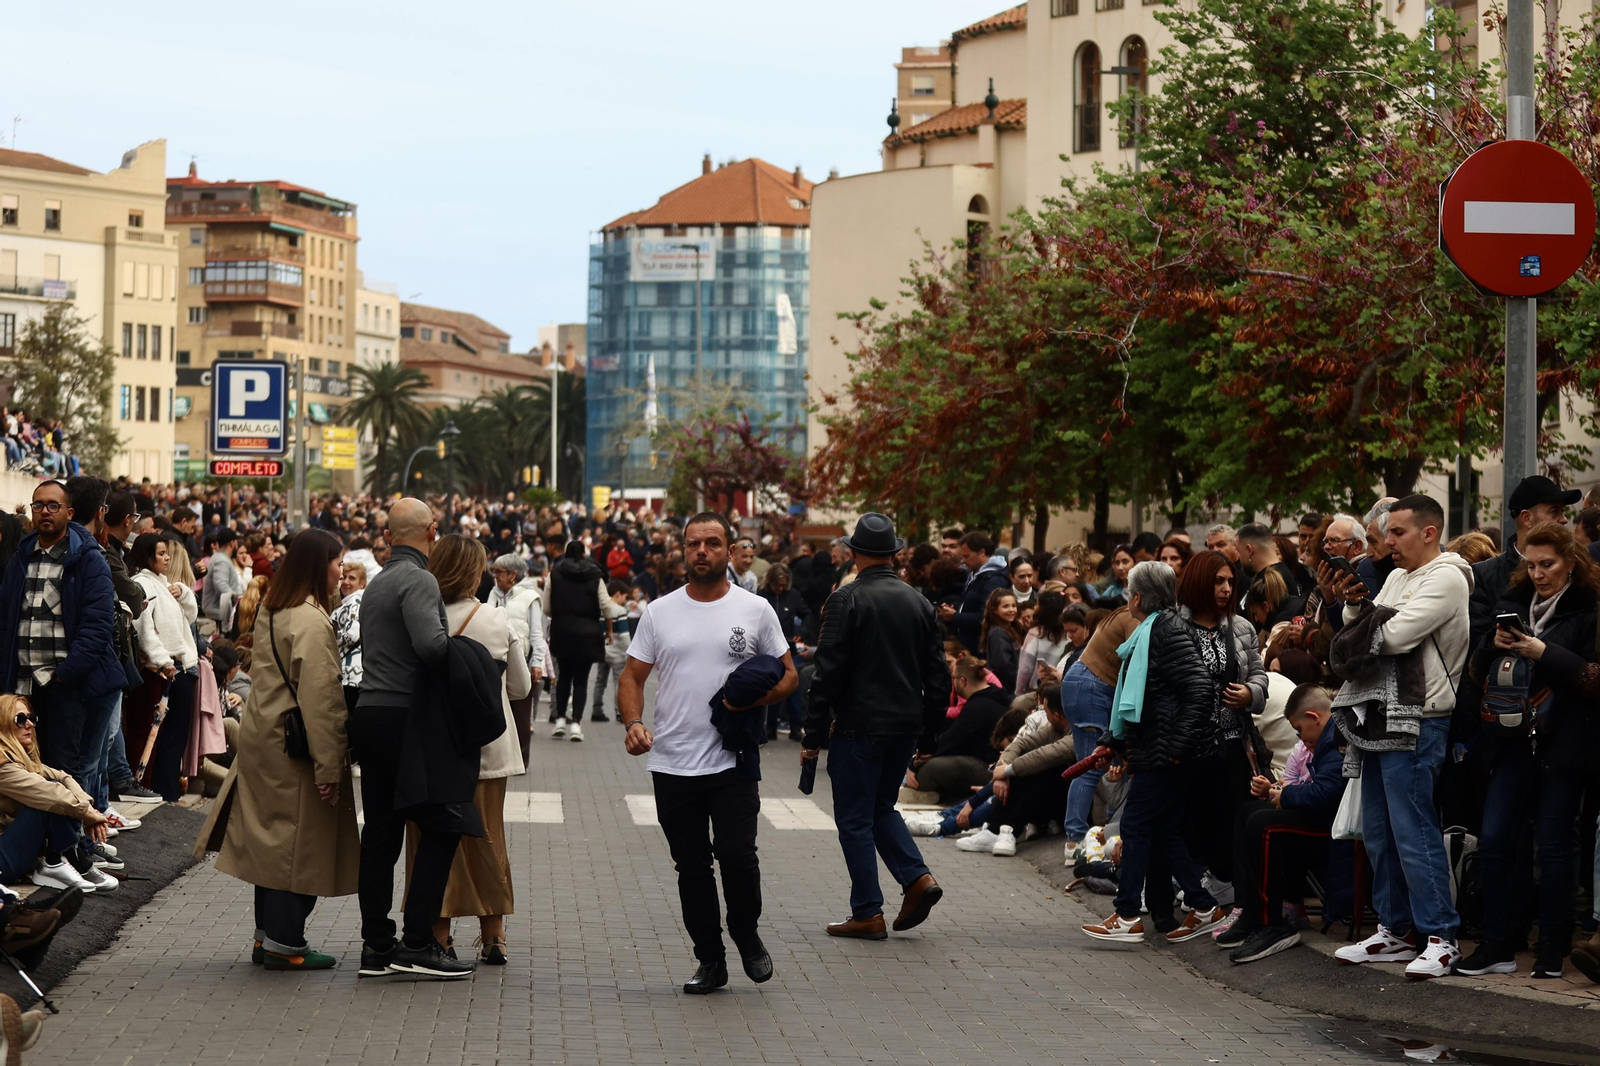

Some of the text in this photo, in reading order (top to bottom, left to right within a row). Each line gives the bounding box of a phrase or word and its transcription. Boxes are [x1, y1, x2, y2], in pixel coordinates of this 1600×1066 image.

[229, 370, 270, 417] P
[231, 438, 267, 446] COMPLETO
[214, 461, 278, 475] COMPLETO
